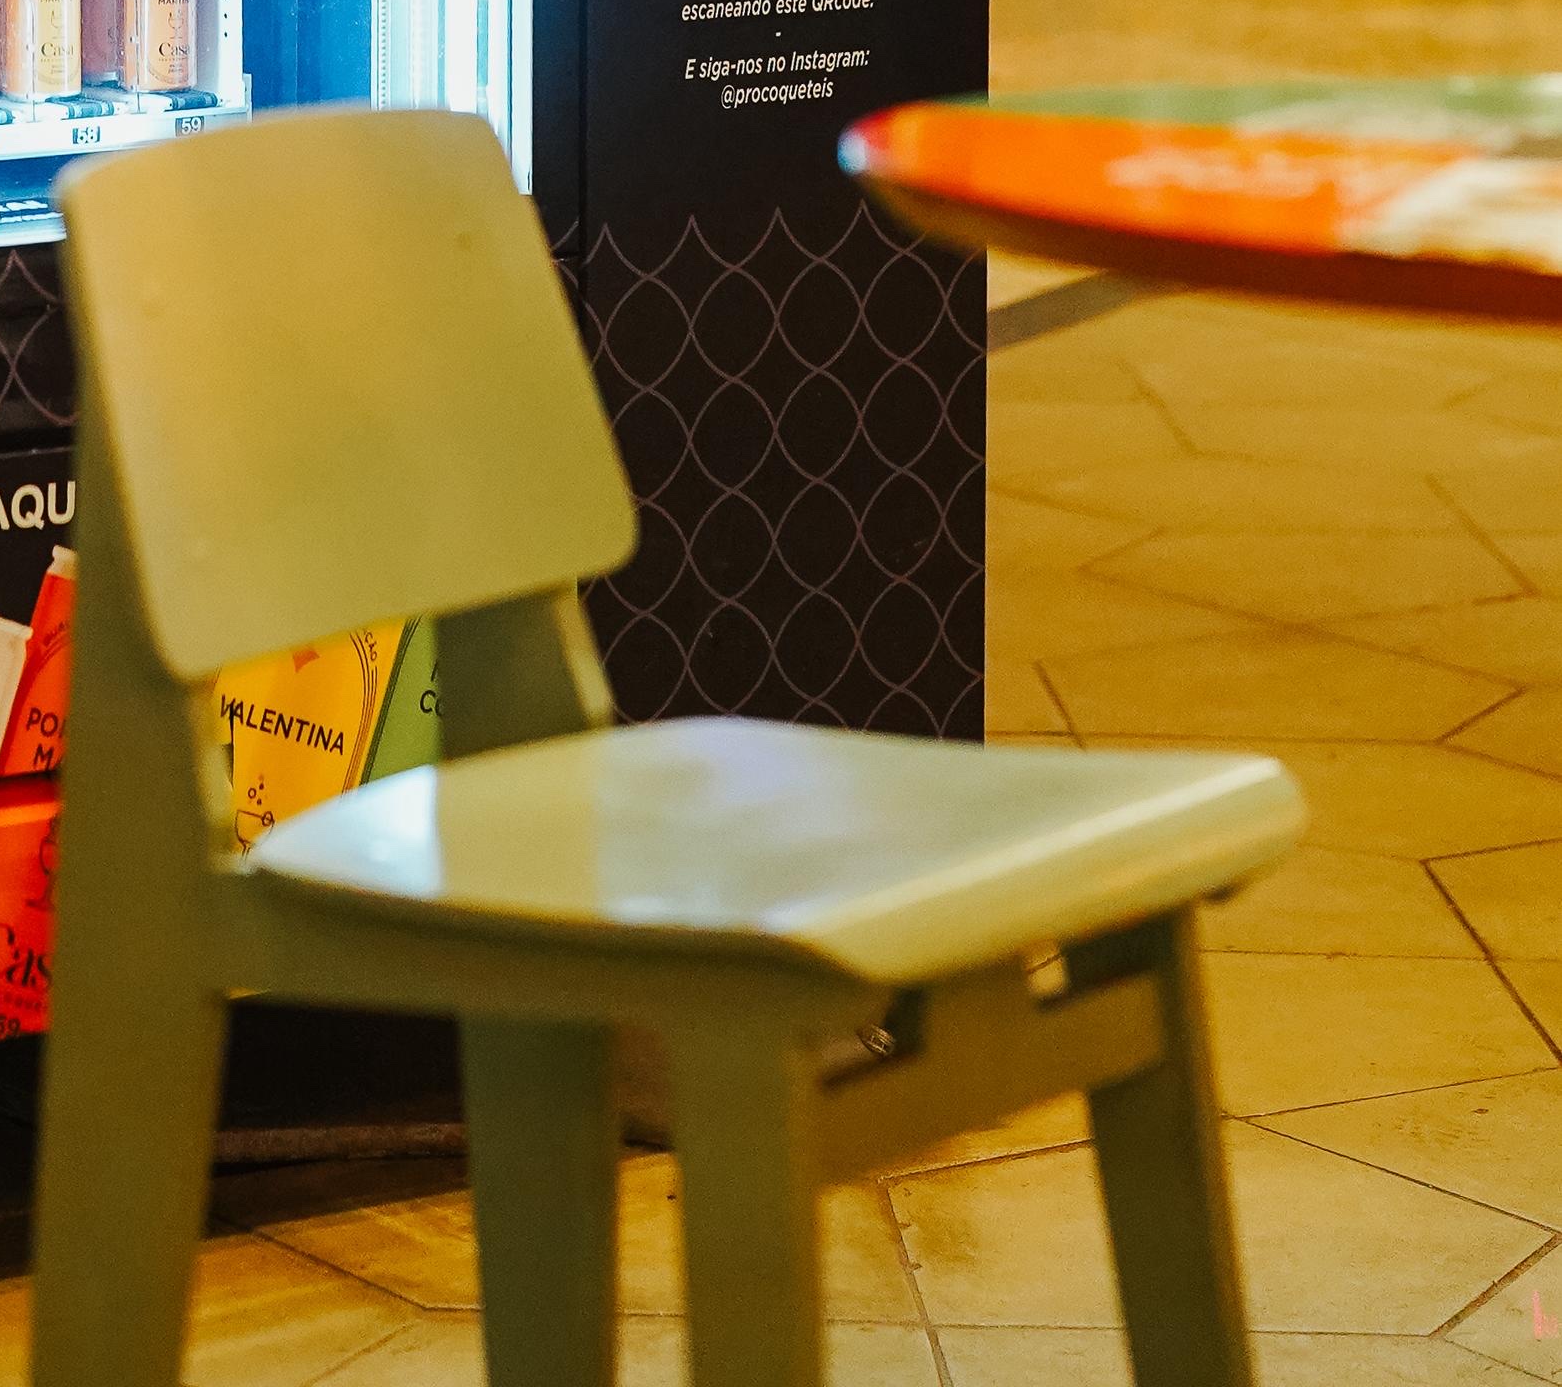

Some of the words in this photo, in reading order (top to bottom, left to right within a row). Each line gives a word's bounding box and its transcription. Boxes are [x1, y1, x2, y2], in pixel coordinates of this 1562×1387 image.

[158, 42, 190, 57] Casa
[685, 59, 696, 80] E
[699, 56, 763, 81] siga-nos
[766, 55, 786, 73] no
[790, 50, 871, 72] Instagram:
[721, 77, 834, 110] @procoqueteis
[182, 117, 202, 134] 59
[219, 693, 345, 756] VALENTINA
